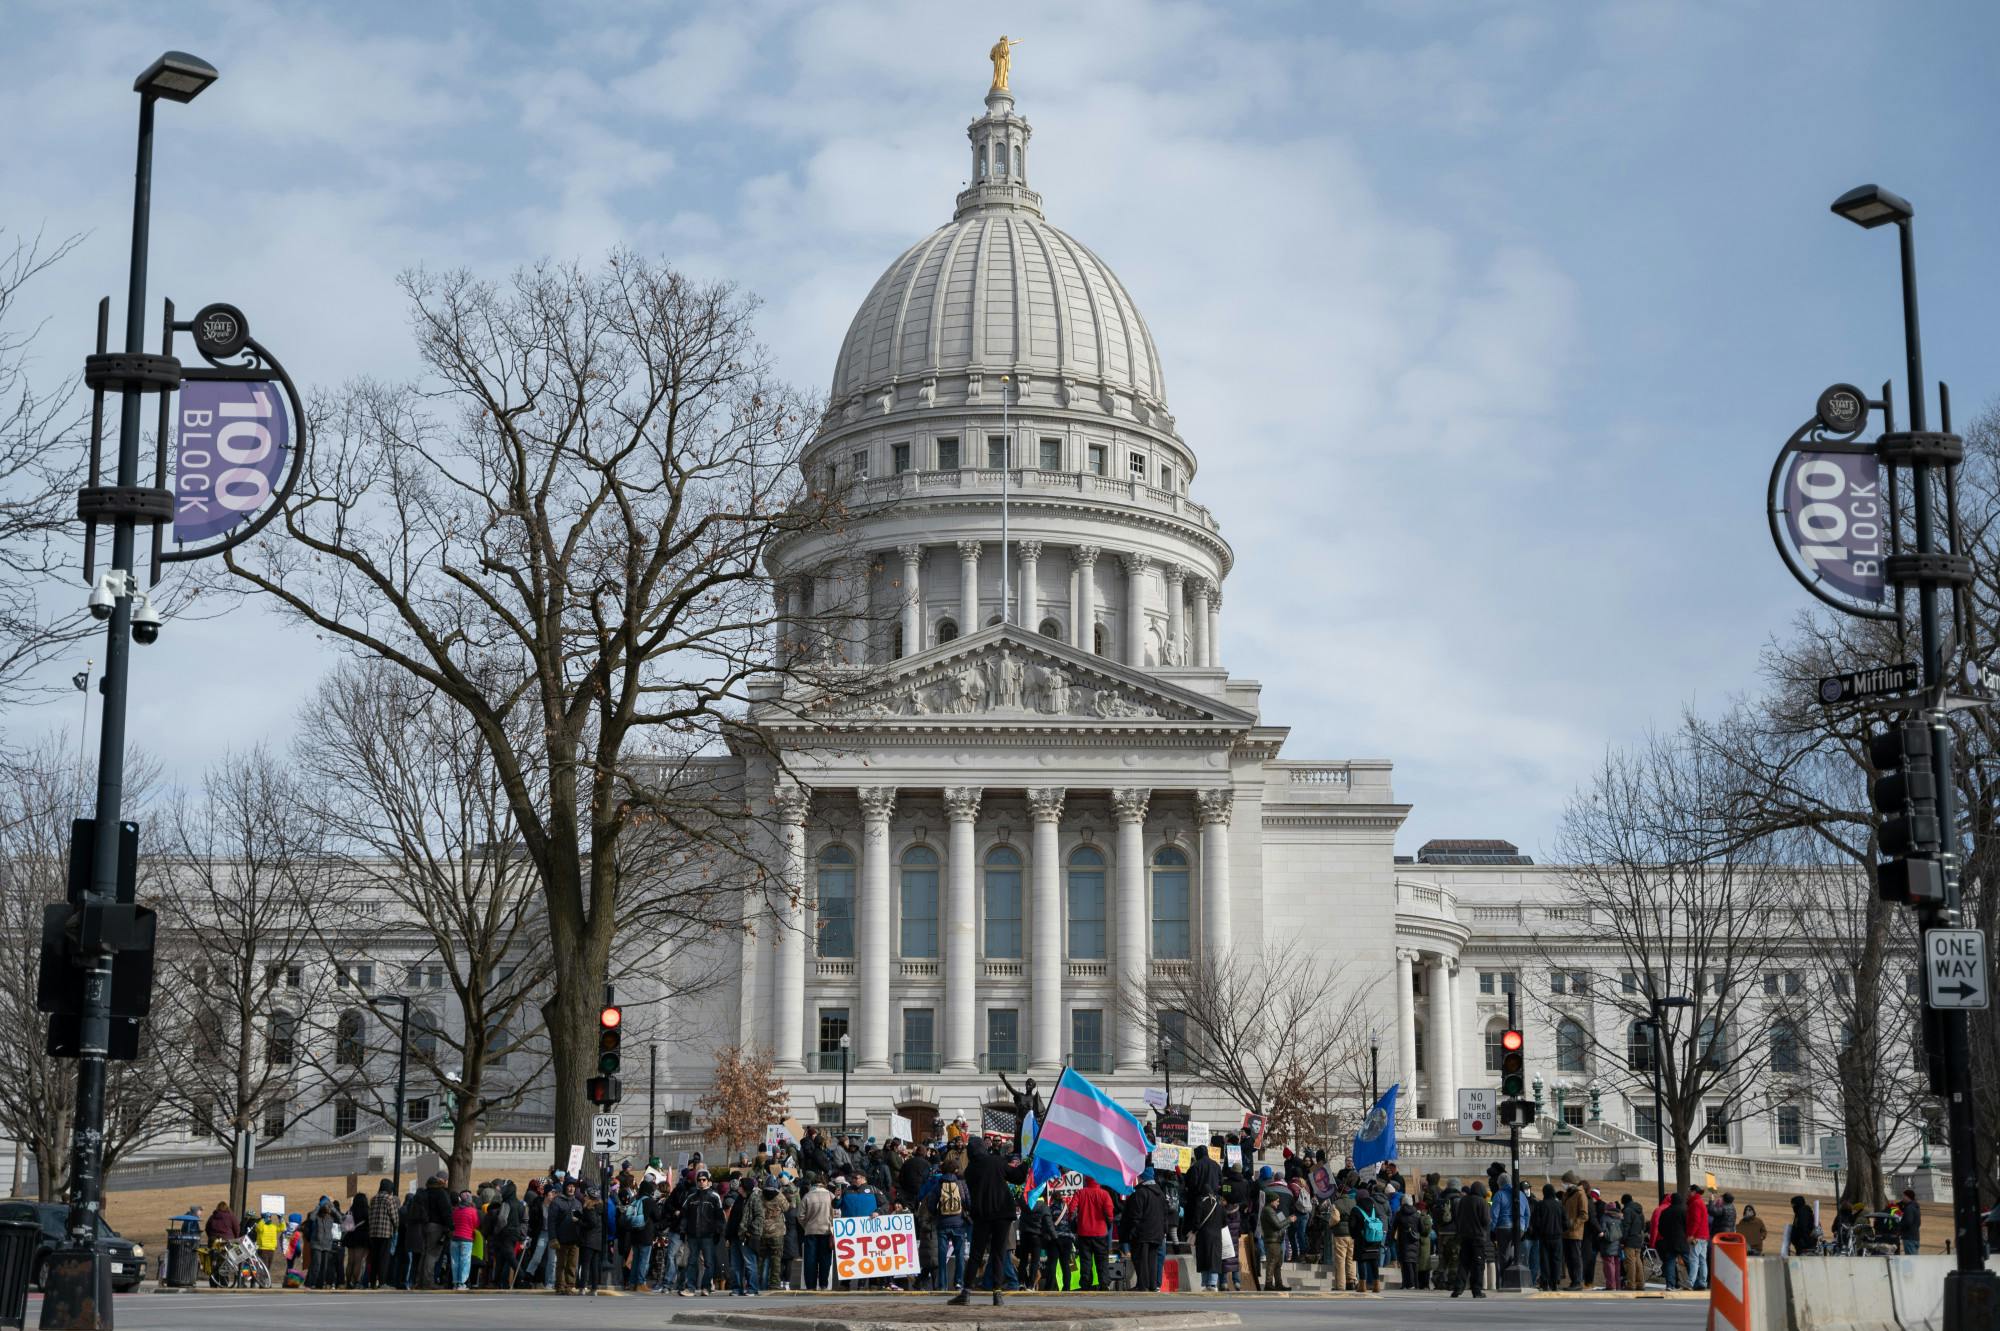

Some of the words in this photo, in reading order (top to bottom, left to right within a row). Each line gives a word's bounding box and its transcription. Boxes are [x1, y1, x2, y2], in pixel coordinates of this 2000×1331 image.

[203, 320, 232, 333] STATE
[215, 391, 273, 511] 100
[179, 410, 213, 513] BLOCK
[1797, 460, 1848, 570] 100
[1850, 481, 1880, 577] BLOCK
[1842, 680, 1850, 692] W
[1853, 668, 1903, 695] Mifflin
[1906, 669, 1916, 681] St
[1935, 938, 1977, 956] ONE
[1935, 960, 1978, 978] WAY
[1470, 1092, 1483, 1102] NO
[1468, 1103, 1487, 1111] TURN
[596, 1117, 617, 1127] ONE
[1463, 1112, 1473, 1120] ON
[1476, 1112, 1491, 1120] RED
[595, 1128, 617, 1138] WAY
[1065, 1173, 1082, 1187] NO
[834, 1218, 856, 1238] DO
[860, 1217, 882, 1234] YOUR
[884, 1215, 913, 1231] JOB
[868, 1250, 887, 1258] THE
